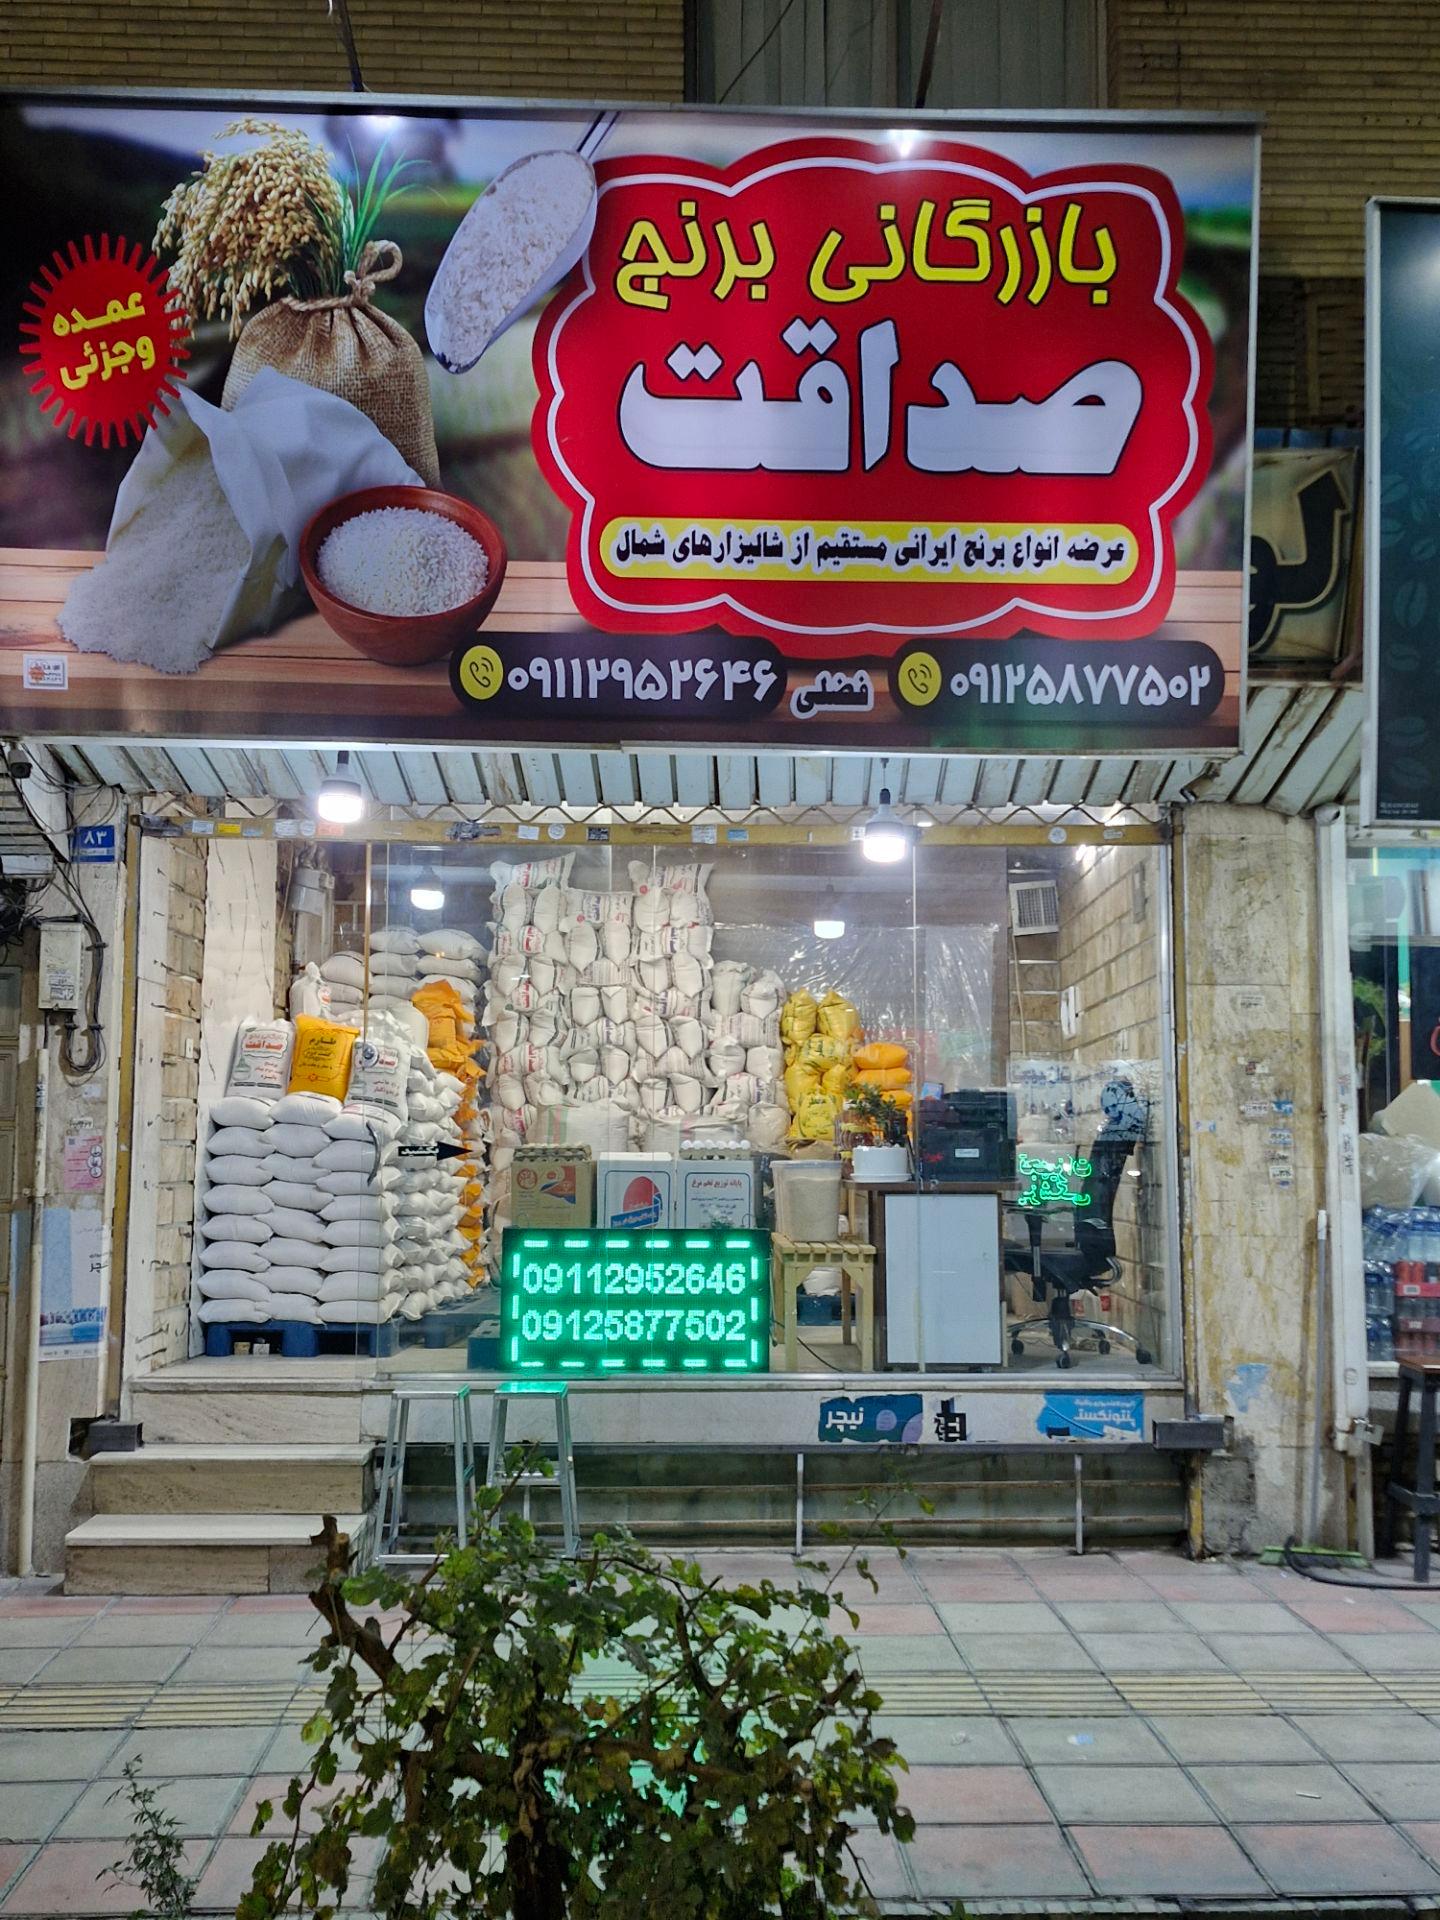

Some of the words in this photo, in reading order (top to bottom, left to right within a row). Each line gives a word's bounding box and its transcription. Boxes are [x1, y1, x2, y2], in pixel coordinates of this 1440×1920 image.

[614, 199, 777, 310] برنج
[809, 199, 1118, 306] بازرگانی
[52, 291, 146, 337] عمده
[618, 316, 1144, 474] صداقت
[616, 528, 666, 562] شمال
[672, 529, 784, 565] شالیزارهای
[790, 532, 810, 565] از
[816, 531, 888, 568] مستقیم
[894, 533, 957, 567] ایرانی
[963, 534, 1006, 568] برنج
[1012, 534, 1060, 568] انواع
[1067, 537, 1125, 569] عرضه
[507, 656, 779, 702] ۰۹۱۱۲۹۵۲۶۴۶
[950, 661, 1212, 707] ۰۹۱۲۵۸۷۷۵۰۲
[83, 830, 108, 845] ۸۳
[522, 1262, 746, 1295] 09112952646
[521, 1309, 746, 1341] 09125877502
[825, 1406, 865, 1433] نیچر
